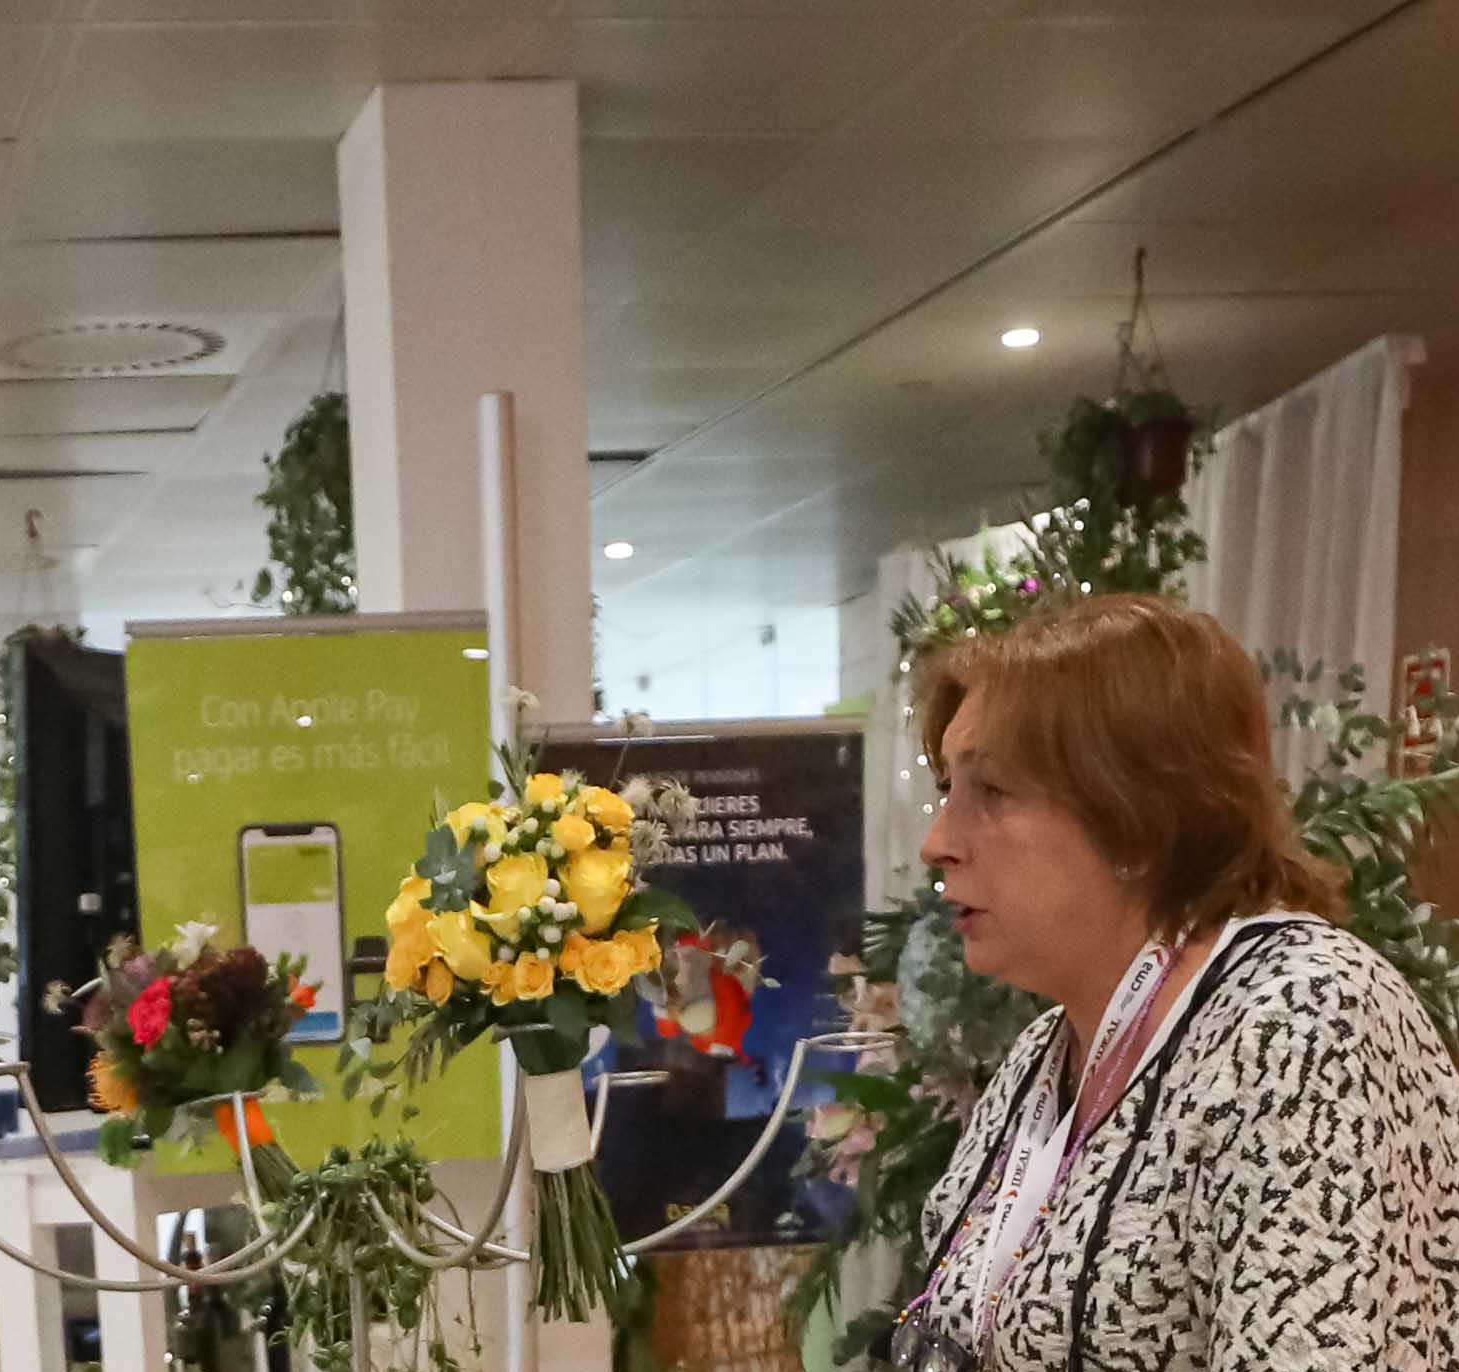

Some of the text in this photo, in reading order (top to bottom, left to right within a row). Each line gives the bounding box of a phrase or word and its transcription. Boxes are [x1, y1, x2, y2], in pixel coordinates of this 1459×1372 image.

[200, 687, 420, 730] Con Apple Pay
[172, 746, 262, 785] pagar
[268, 744, 306, 772] es
[312, 734, 382, 771] más
[728, 817, 815, 840] SIEMPRE,
[700, 845, 730, 863] UN
[734, 842, 788, 863] PLAN.
[1131, 961, 1154, 992] cma
